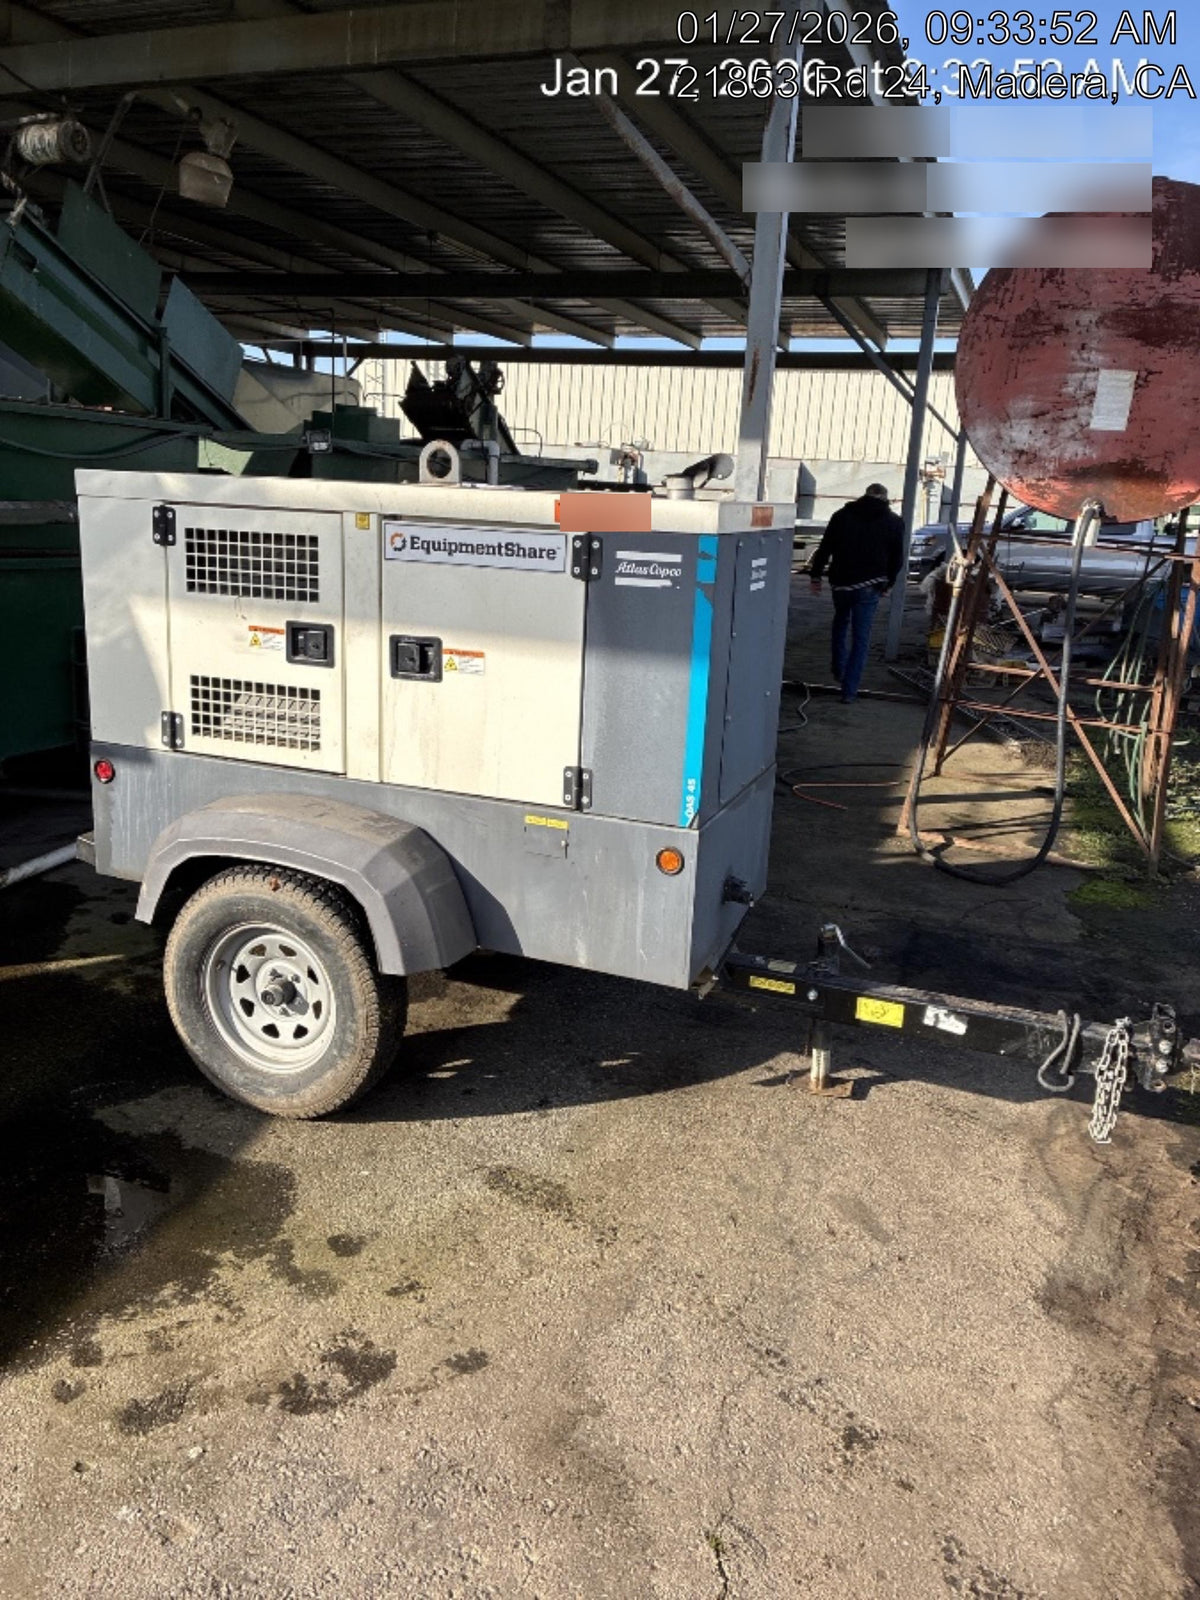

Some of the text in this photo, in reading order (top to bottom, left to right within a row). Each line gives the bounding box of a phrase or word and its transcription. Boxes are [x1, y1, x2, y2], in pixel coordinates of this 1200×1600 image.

[409, 535, 558, 561] EquipmentShare
[615, 561, 682, 578] Atlas Copco
